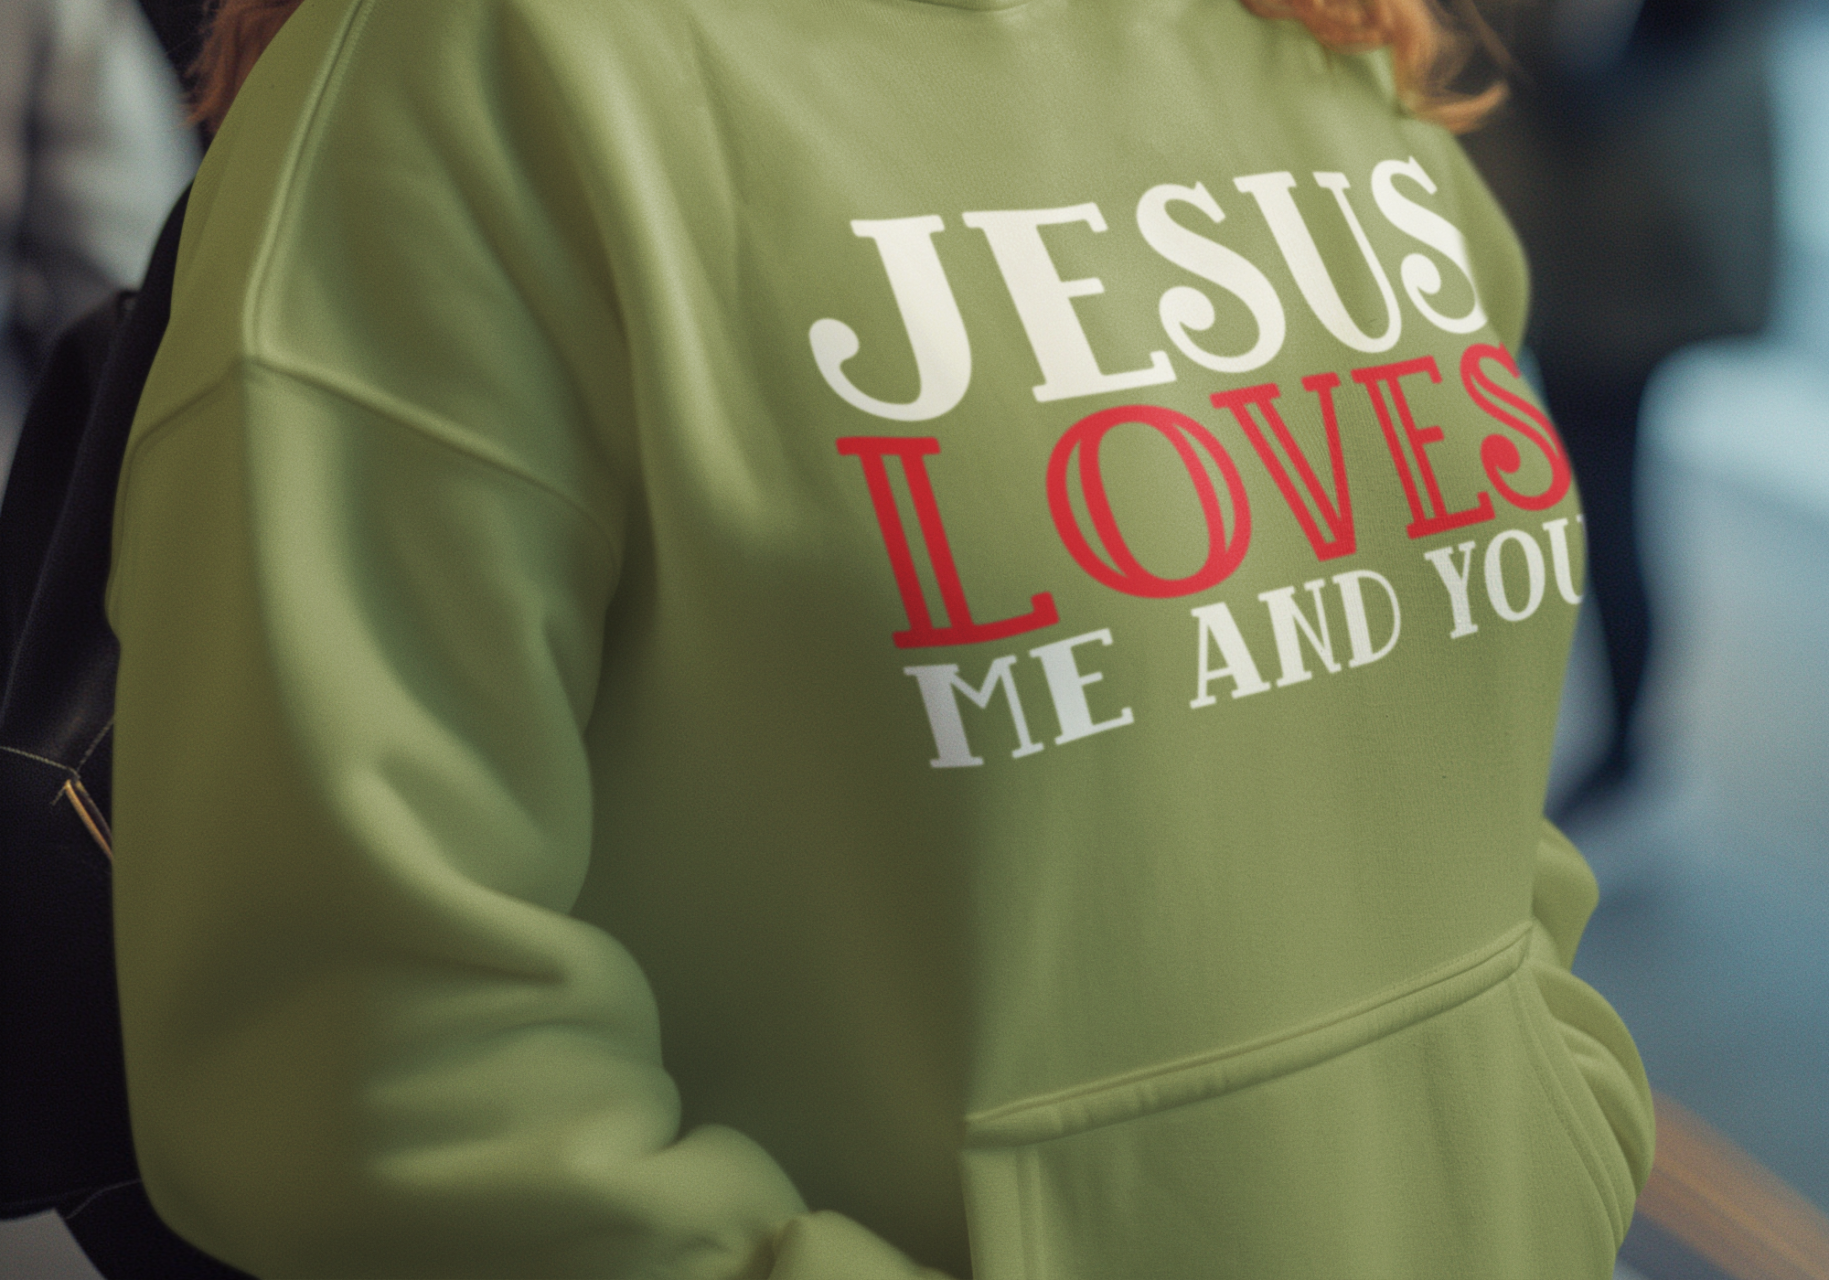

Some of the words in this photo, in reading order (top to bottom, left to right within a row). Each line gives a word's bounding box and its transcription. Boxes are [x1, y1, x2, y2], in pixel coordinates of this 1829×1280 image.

[808, 156, 1488, 422] JESUS
[836, 342, 1572, 649] LOVES
[904, 628, 1134, 768] ME
[1190, 570, 1402, 709] AND
